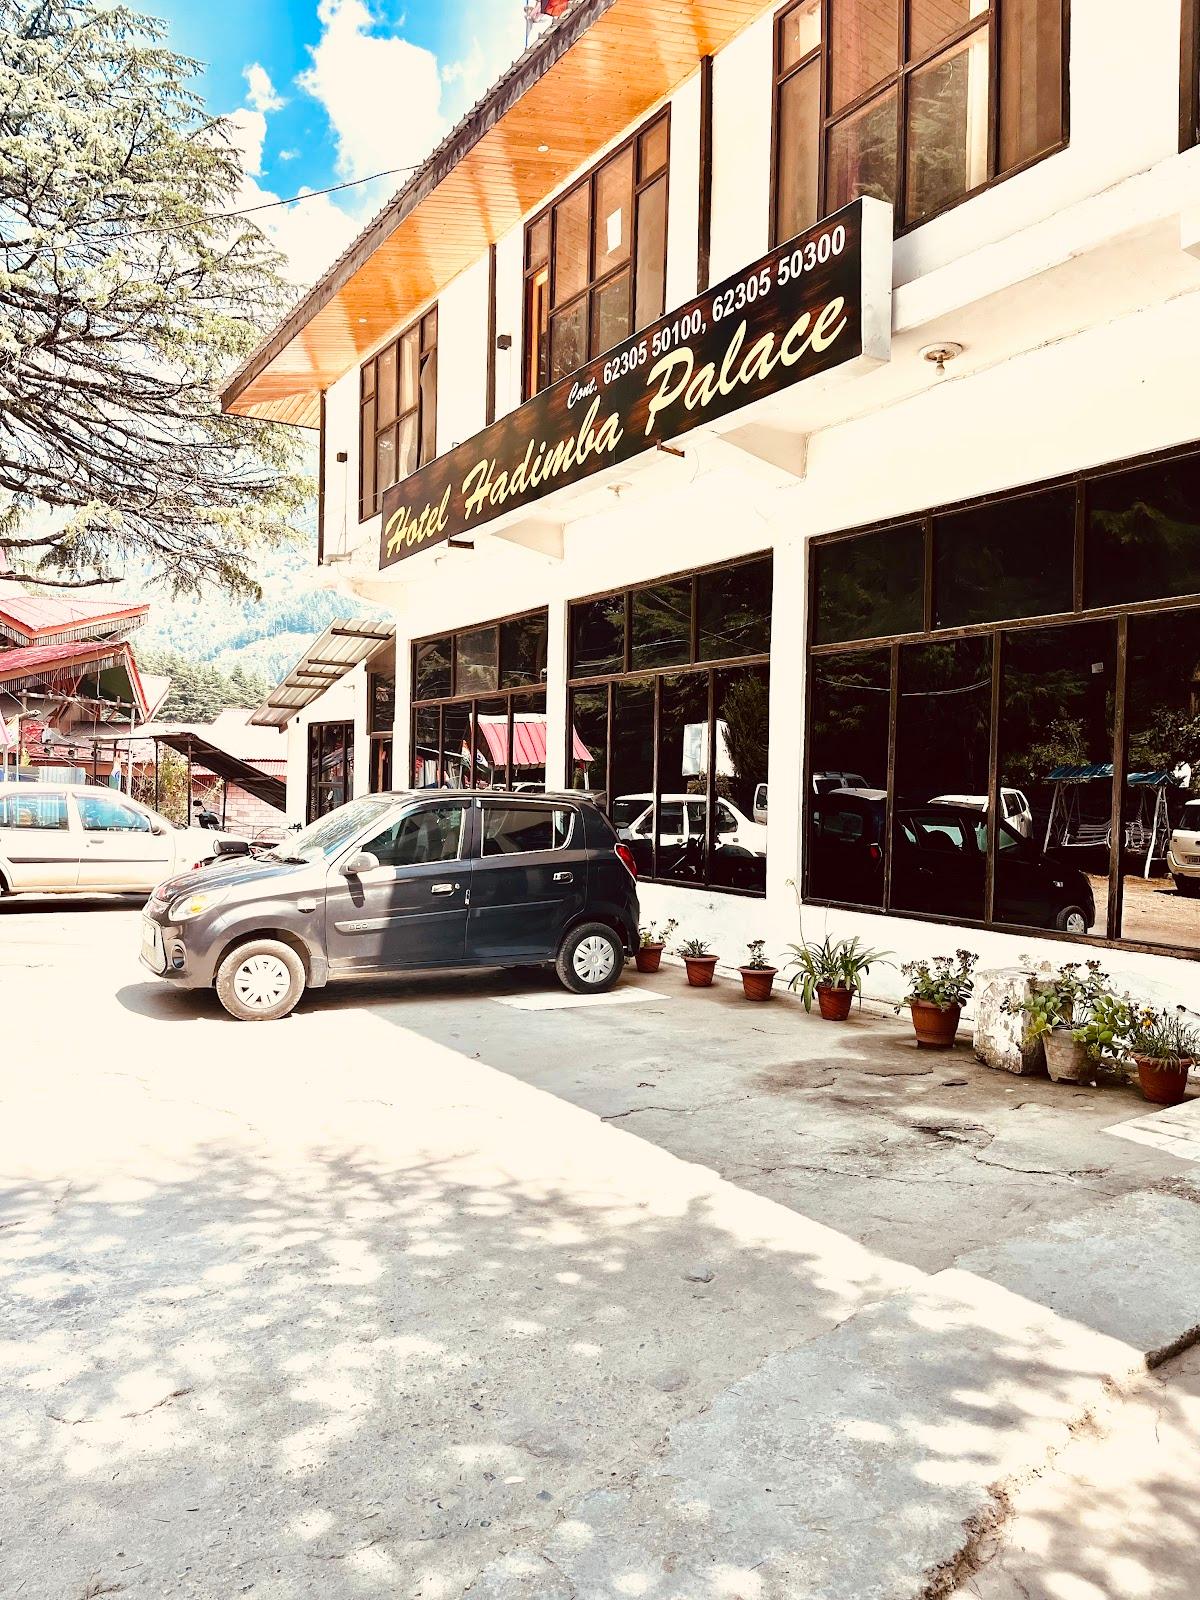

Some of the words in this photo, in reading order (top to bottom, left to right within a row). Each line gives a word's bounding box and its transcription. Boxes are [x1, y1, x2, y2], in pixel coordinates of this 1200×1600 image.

[385, 483, 451, 558] Hotel
[461, 395, 623, 520] Hadimba
[644, 296, 848, 436] Palace
[567, 376, 598, 409] Cont.
[603, 339, 648, 385] 62305
[651, 309, 707, 357] 50100,
[712, 266, 772, 322] 62305
[776, 225, 846, 286] 50300
